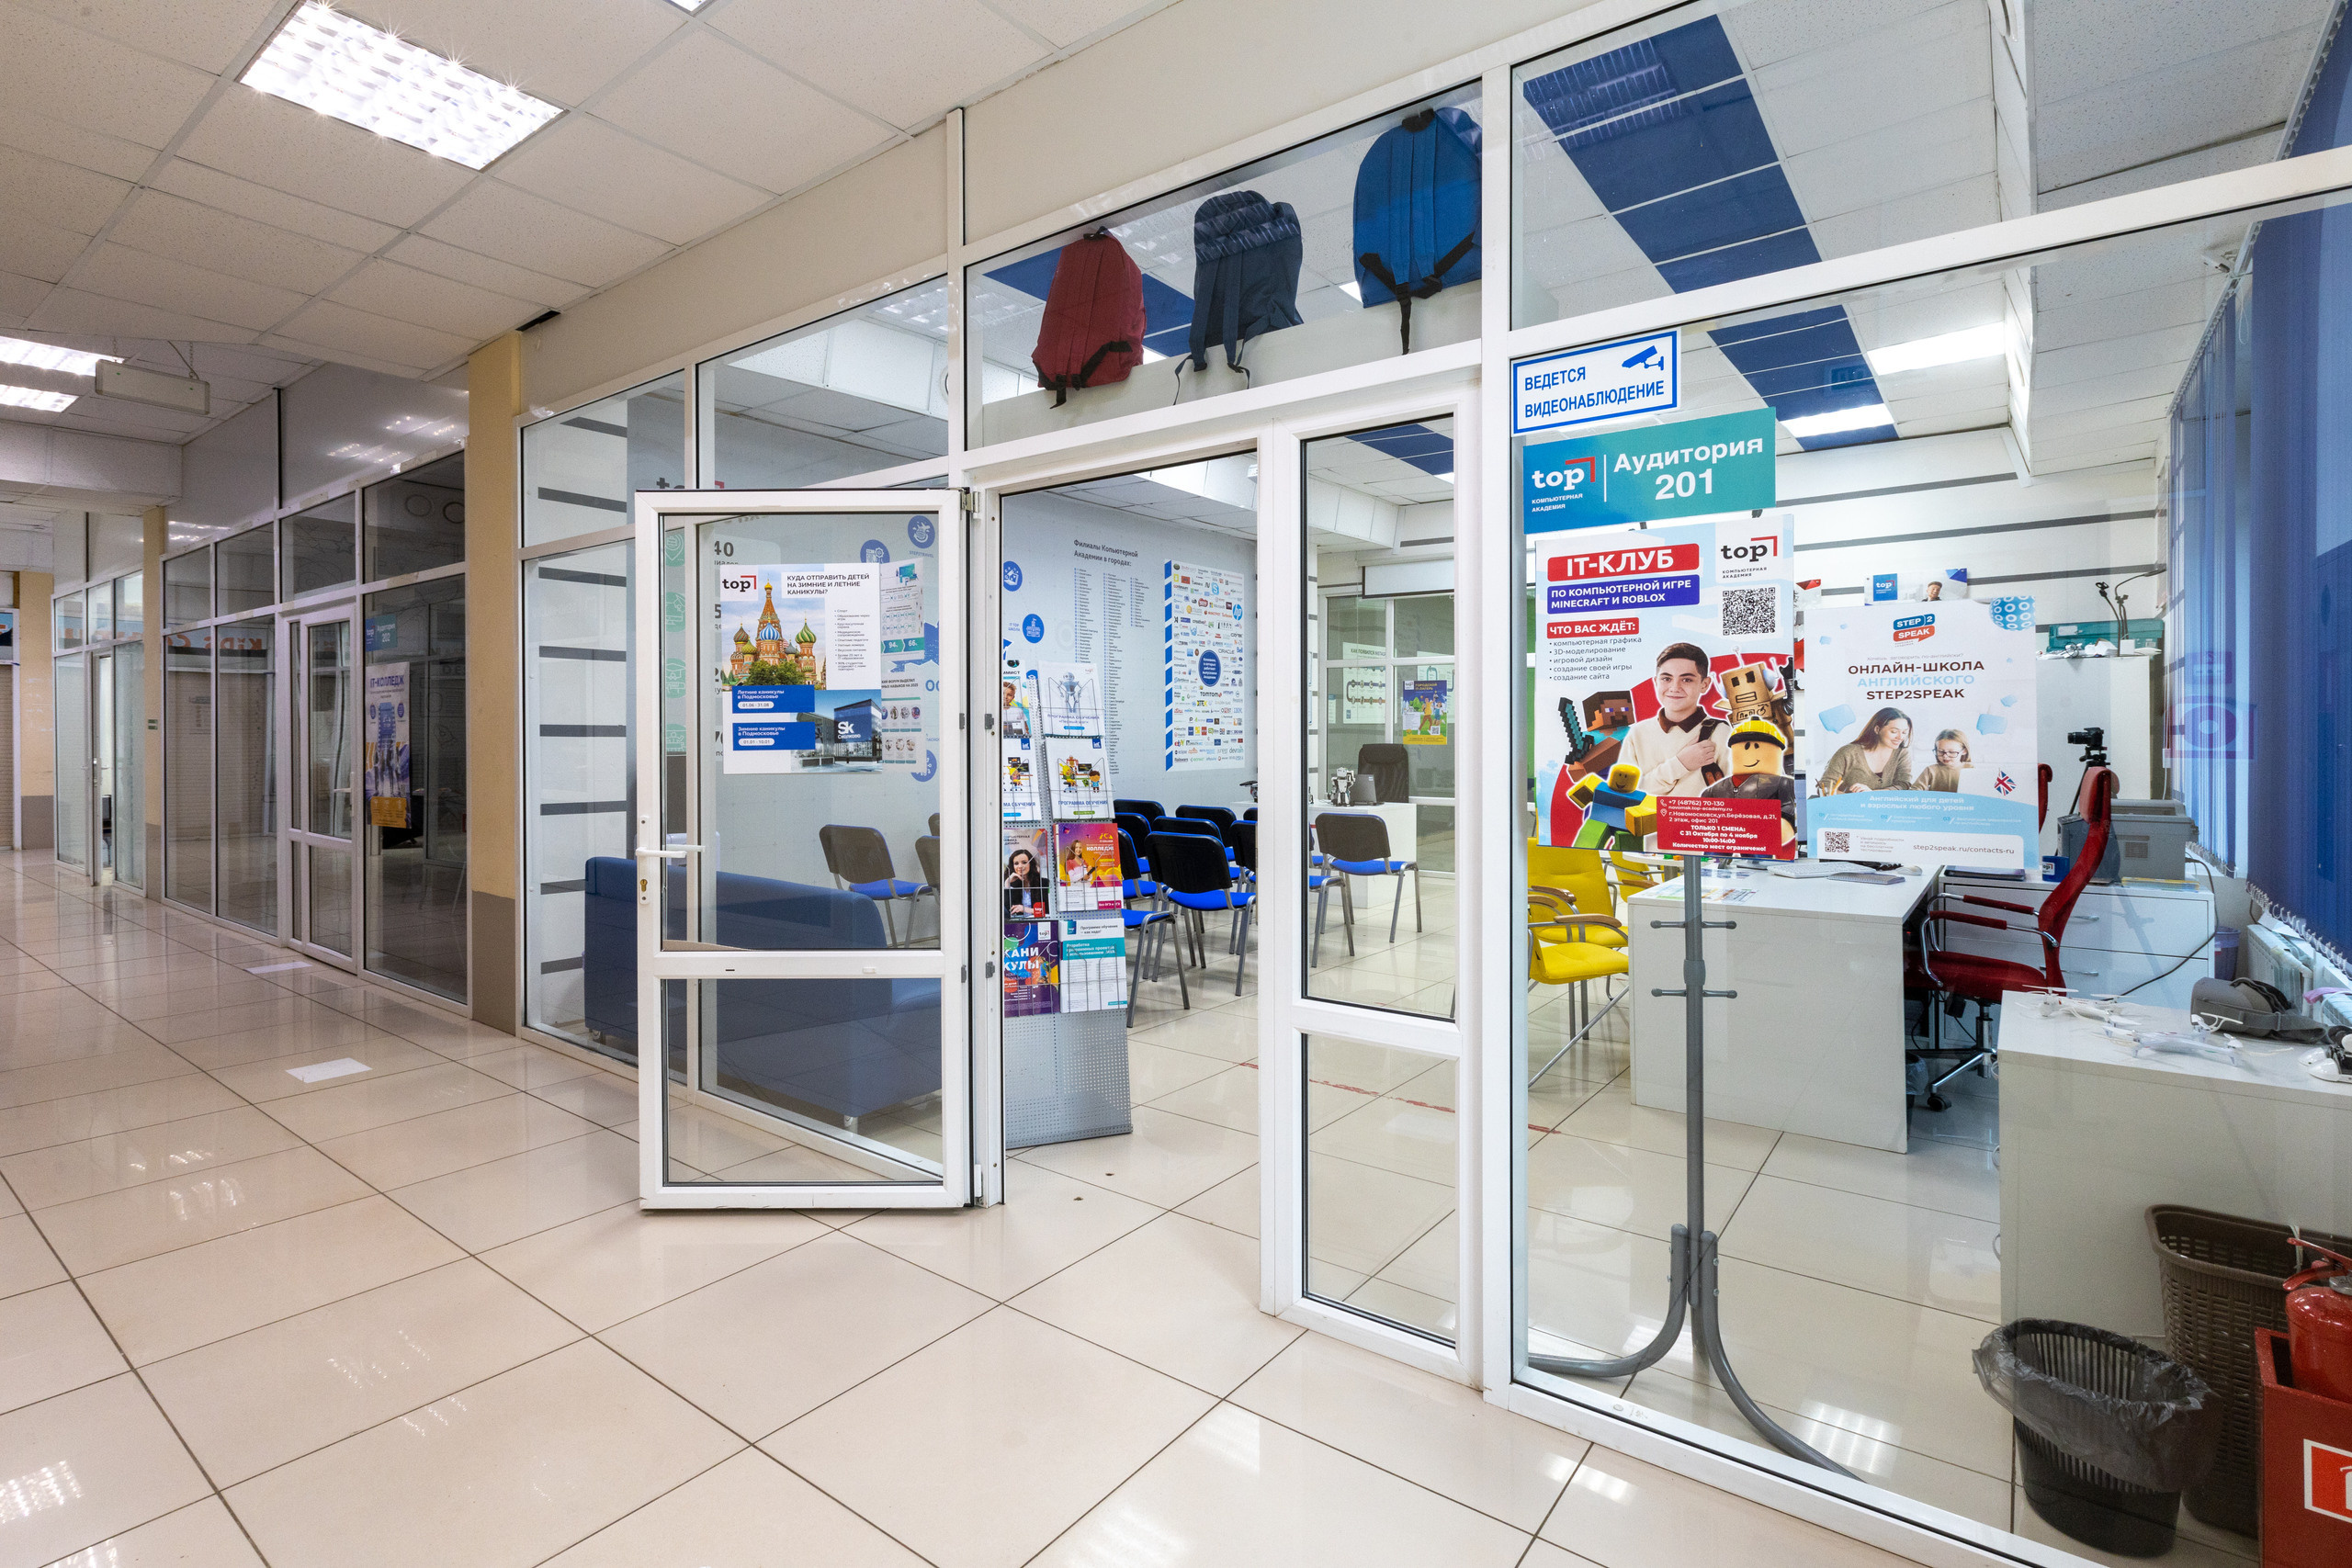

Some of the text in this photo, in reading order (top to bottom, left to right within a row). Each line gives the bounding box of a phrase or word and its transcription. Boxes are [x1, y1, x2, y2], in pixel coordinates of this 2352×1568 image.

[1525, 367, 1586, 391] ВЕДЕТСЯ
[1525, 380, 1664, 418] ВИДЕОНАБЛЮДЕНИЕ
[1613, 438, 1763, 475] Аудитория
[1532, 468, 1585, 491] top
[1655, 468, 1713, 501] 201
[1532, 492, 1583, 504] КОМПЬЮТЕРНАЯ
[1532, 503, 1566, 513] АКАДЕМИЯ
[1074, 539, 1101, 550] Филиалы
[1074, 550, 1102, 562] Академии
[1108, 558, 1132, 566] городах:
[1721, 543, 1768, 562] top
[1566, 548, 1674, 577] IT-КЛУБ
[847, 573, 870, 581] ДЕТЕЙ
[722, 579, 751, 592] top
[1551, 580, 1691, 598] ПО КОМПЬЮТЕРНОЙ ИГРЕ
[1551, 593, 1666, 609] MINECRAFT И ROBLOX
[1549, 621, 1636, 635] ЧТО ВАС ЖДЁТ:
[1896, 617, 1921, 627] STEP
[1898, 628, 1930, 639] SPEAK
[1554, 637, 1642, 647] компьютерная графика
[1554, 647, 1626, 655] 3D-моделирование
[1554, 655, 1612, 664] игровой дизайн
[1848, 660, 1984, 675] ОНЛАЙН-ШКОЛА
[1857, 673, 1975, 688] АНГЛИЙСКОГО
[1866, 689, 1965, 700] STEP2SPEAK
[838, 721, 854, 734] Sk
[1868, 802, 1907, 811] взрослых
[1870, 795, 1918, 804] Английский
[1939, 796, 1964, 805] детей
[1913, 844, 2015, 854] step2speak.ru/contacts-ru
